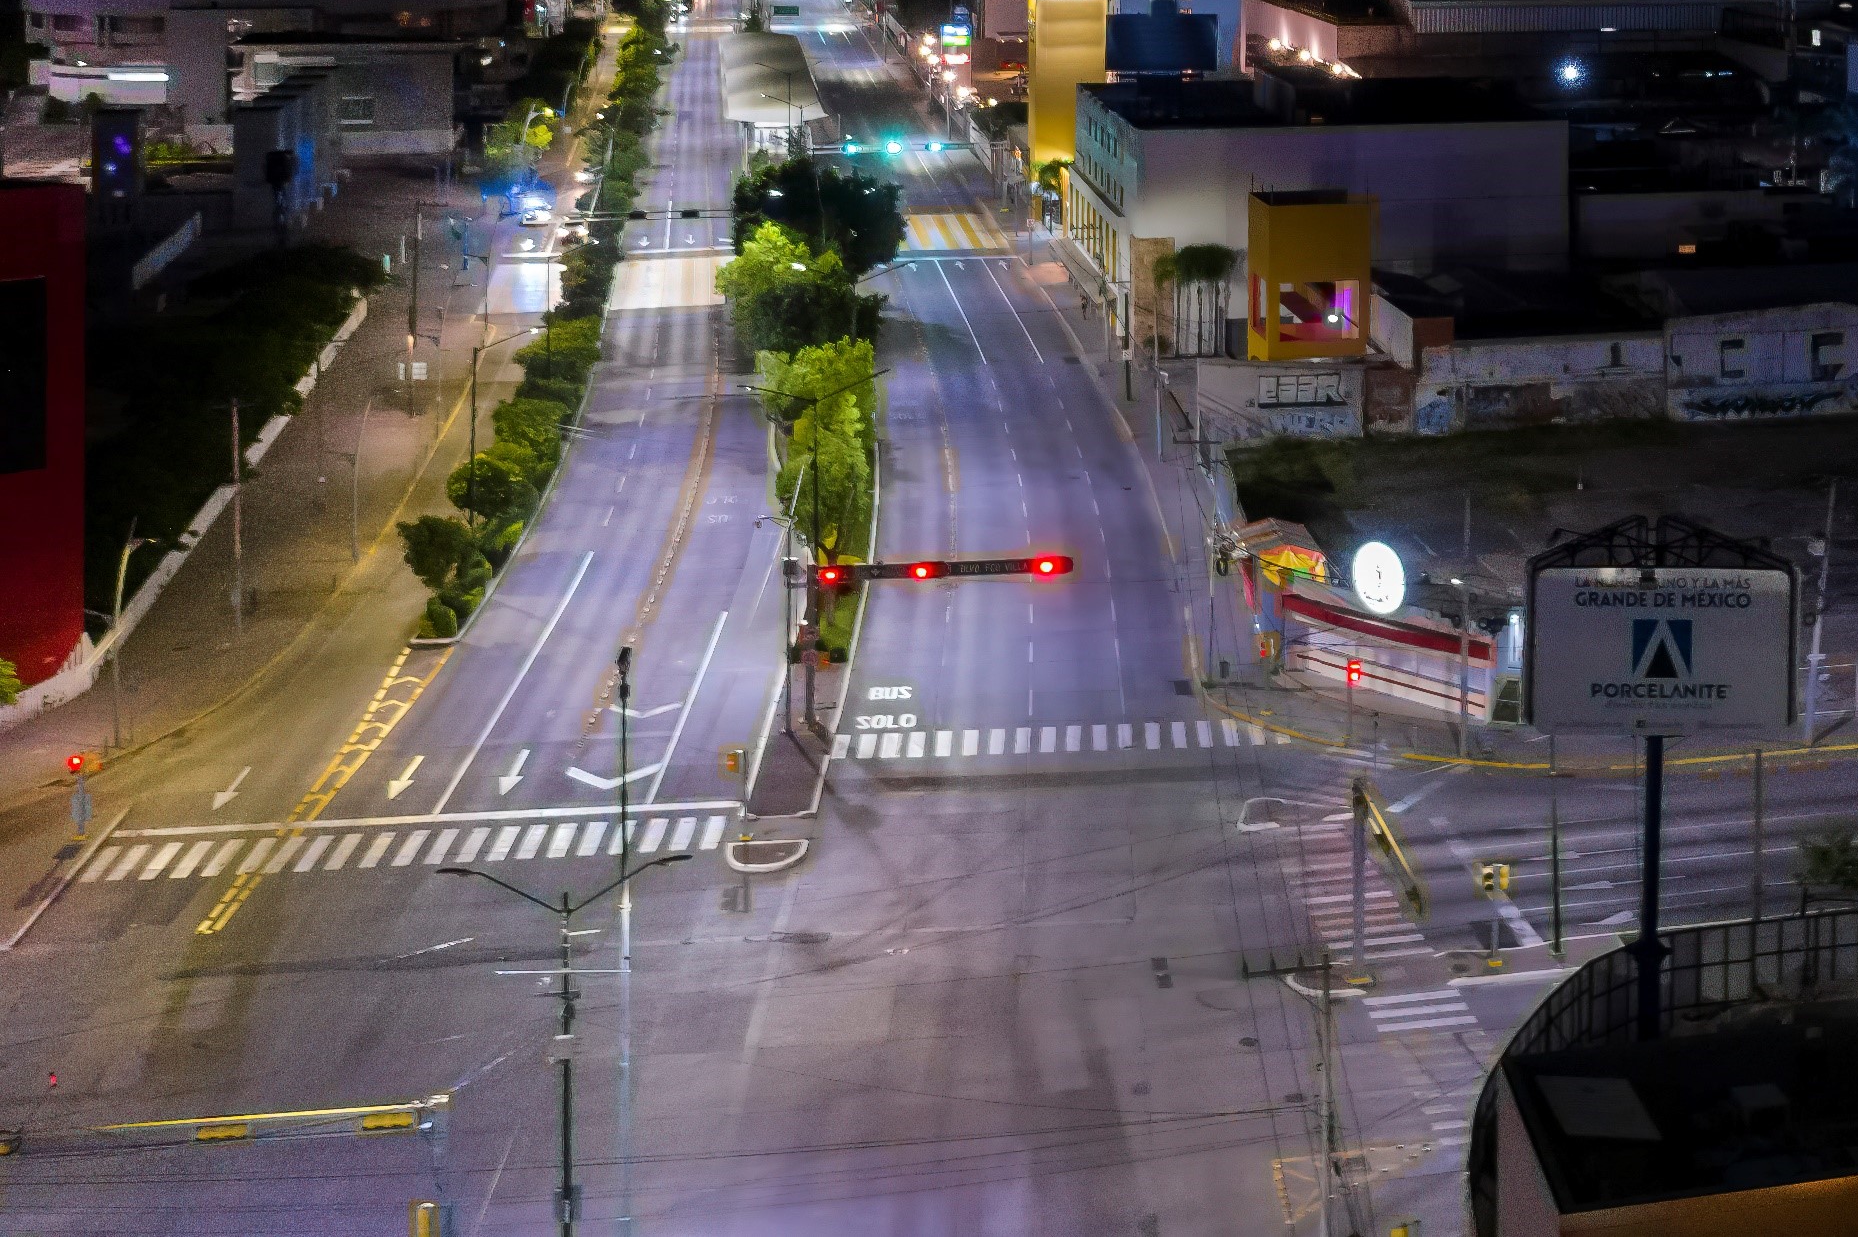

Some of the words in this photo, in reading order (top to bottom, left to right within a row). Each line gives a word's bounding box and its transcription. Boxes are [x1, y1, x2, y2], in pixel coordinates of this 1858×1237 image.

[1703, 577, 1720, 589] LA
[1575, 591, 1648, 607] GRANDE
[1653, 592, 1676, 607] DE
[1680, 590, 1752, 608] MÉXICO
[868, 685, 913, 701] BUS
[1590, 683, 1728, 699] PORCELANITE
[855, 713, 918, 730] SOLO
